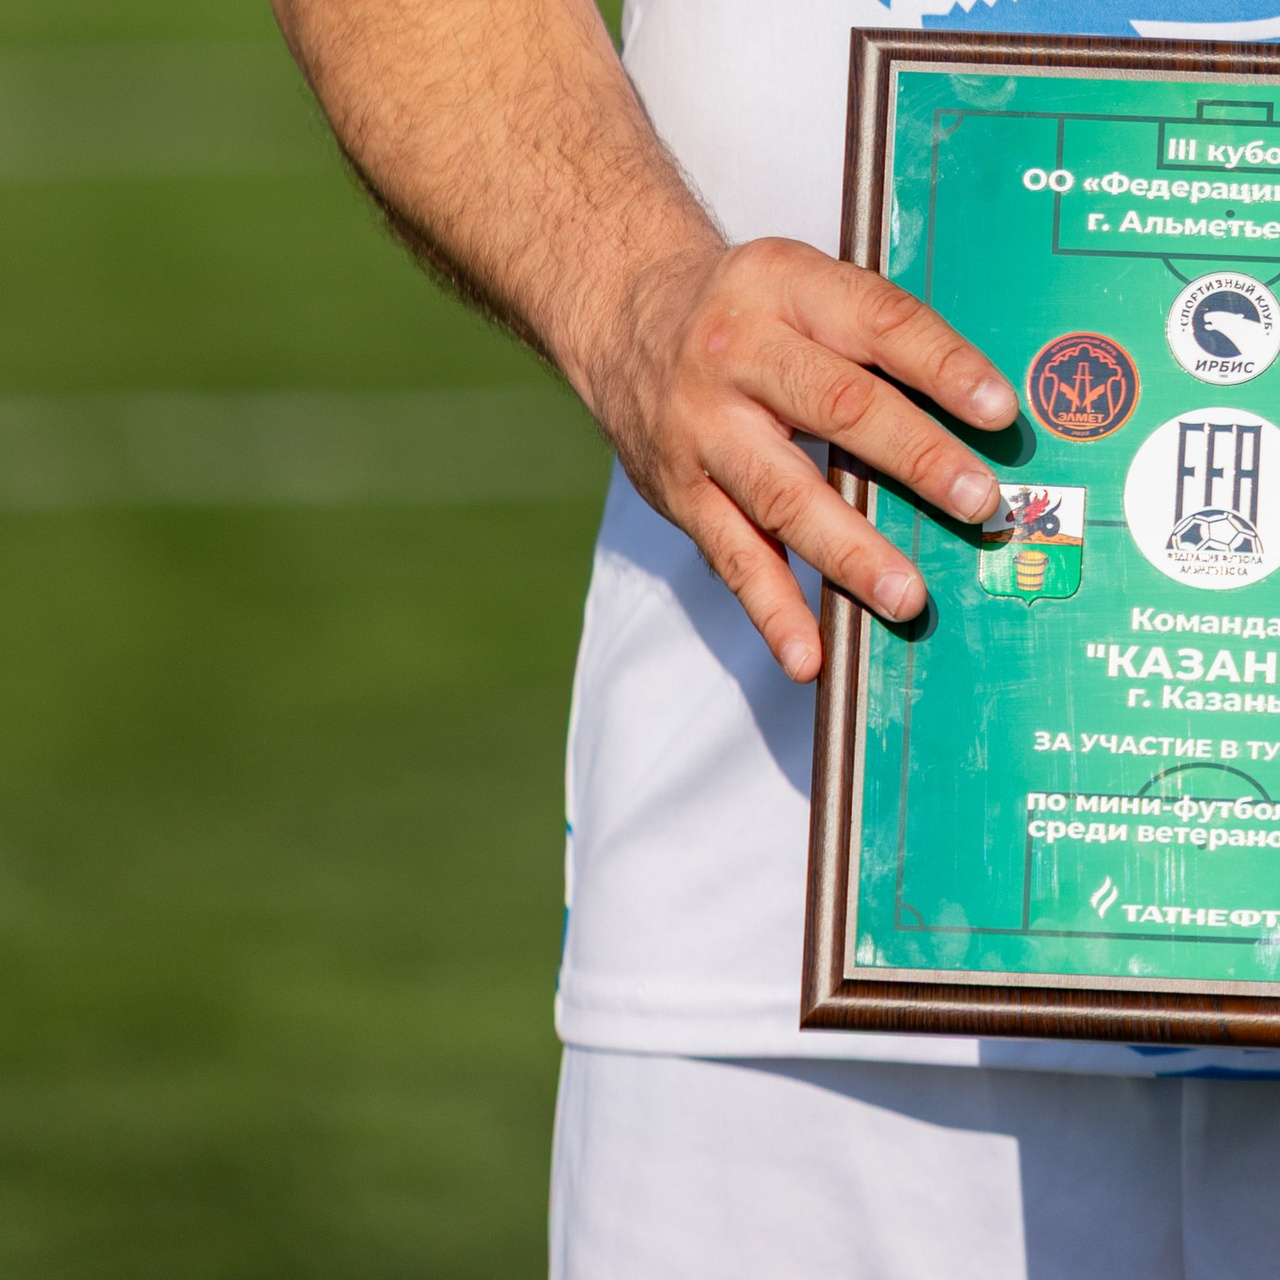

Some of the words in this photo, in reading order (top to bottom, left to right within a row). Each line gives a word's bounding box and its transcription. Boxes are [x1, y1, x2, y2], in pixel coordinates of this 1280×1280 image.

[1087, 211, 1110, 233] г.
[1254, 295, 1273, 331] КЛУБ
[1195, 360, 1255, 374] ИРБИС
[1058, 412, 1105, 423] ЭЛМЕТ
[1127, 688, 1151, 708] г.
[1033, 731, 1072, 752] ЗА
[1080, 733, 1212, 758] УЧАСТИЕ
[1220, 740, 1239, 760] В
[1026, 792, 1067, 811] по
[1027, 819, 1128, 843] среди
